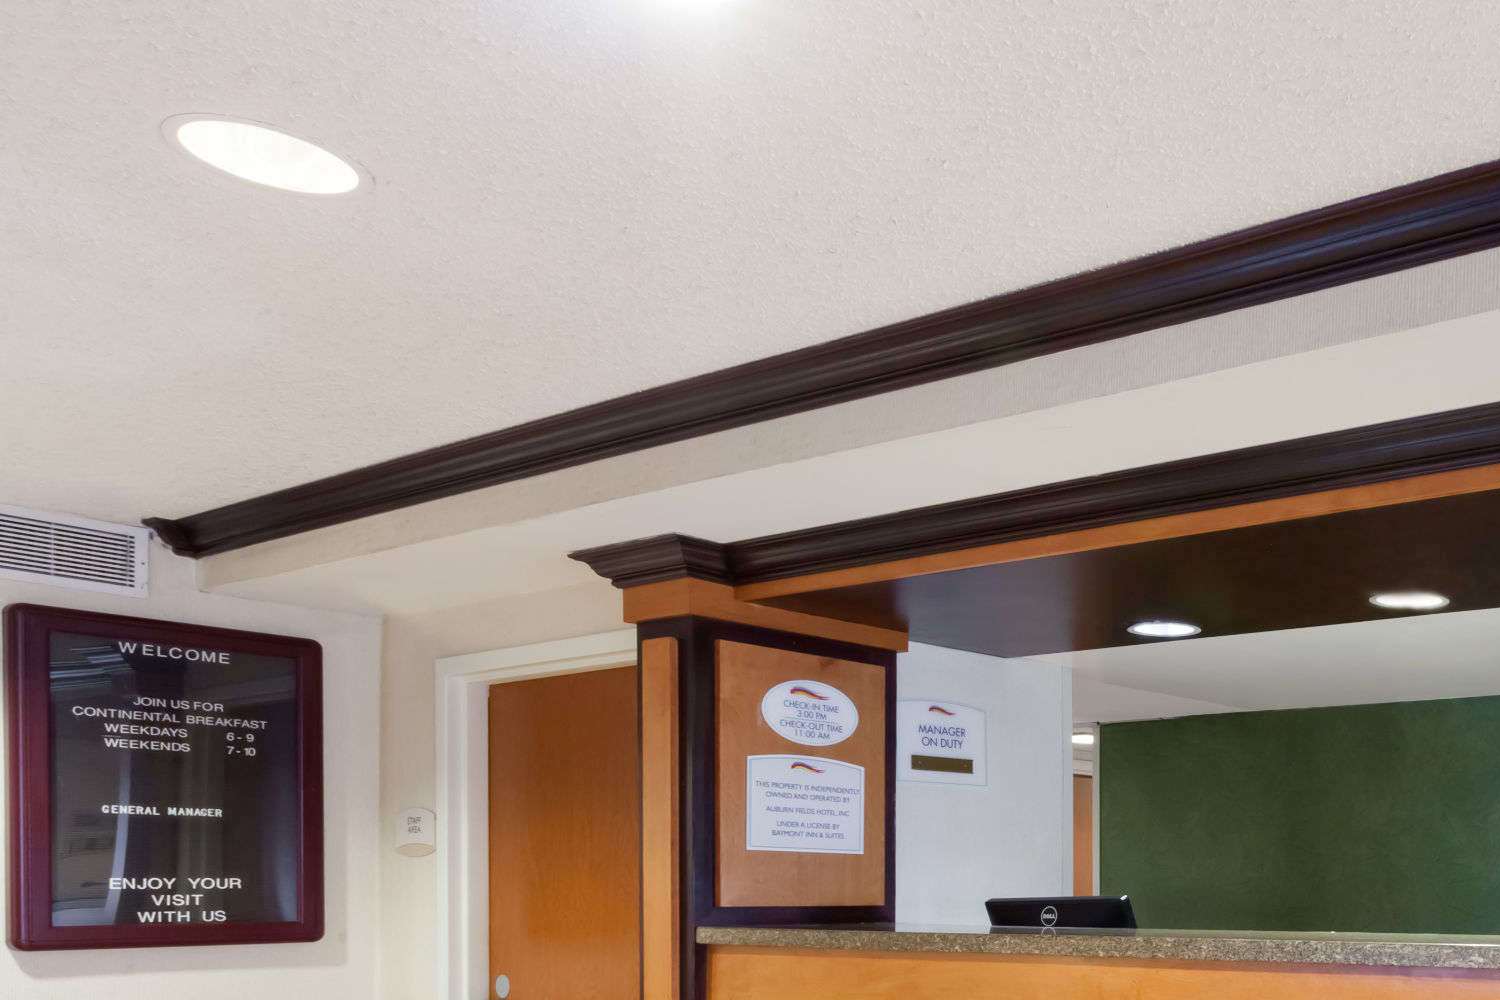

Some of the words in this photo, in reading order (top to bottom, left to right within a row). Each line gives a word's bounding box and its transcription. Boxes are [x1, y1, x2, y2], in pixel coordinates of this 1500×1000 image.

[118, 641, 231, 664] WELCOME
[133, 696, 167, 708] JOIN
[170, 700, 190, 710] US
[193, 701, 224, 712] FOR
[822, 704, 840, 714] TIME
[72, 706, 181, 723] CONTINENTAL
[186, 715, 268, 730] BREAKFAST
[815, 712, 828, 721] PM
[104, 723, 188, 739] WEEKDAYS
[817, 732, 831, 740] AM
[827, 725, 844, 734] TIME
[918, 724, 966, 738] MANAGER
[104, 737, 191, 752] WEEKENDS
[921, 736, 938, 747] ON
[940, 738, 963, 749] DUTY
[101, 805, 160, 816] GENERAL
[167, 806, 223, 818] MANAGER
[108, 877, 176, 890] ENJOY
[187, 877, 242, 890] YOUR
[151, 894, 204, 906] VISIT
[137, 911, 191, 923] WITH
[201, 910, 227, 922] US
